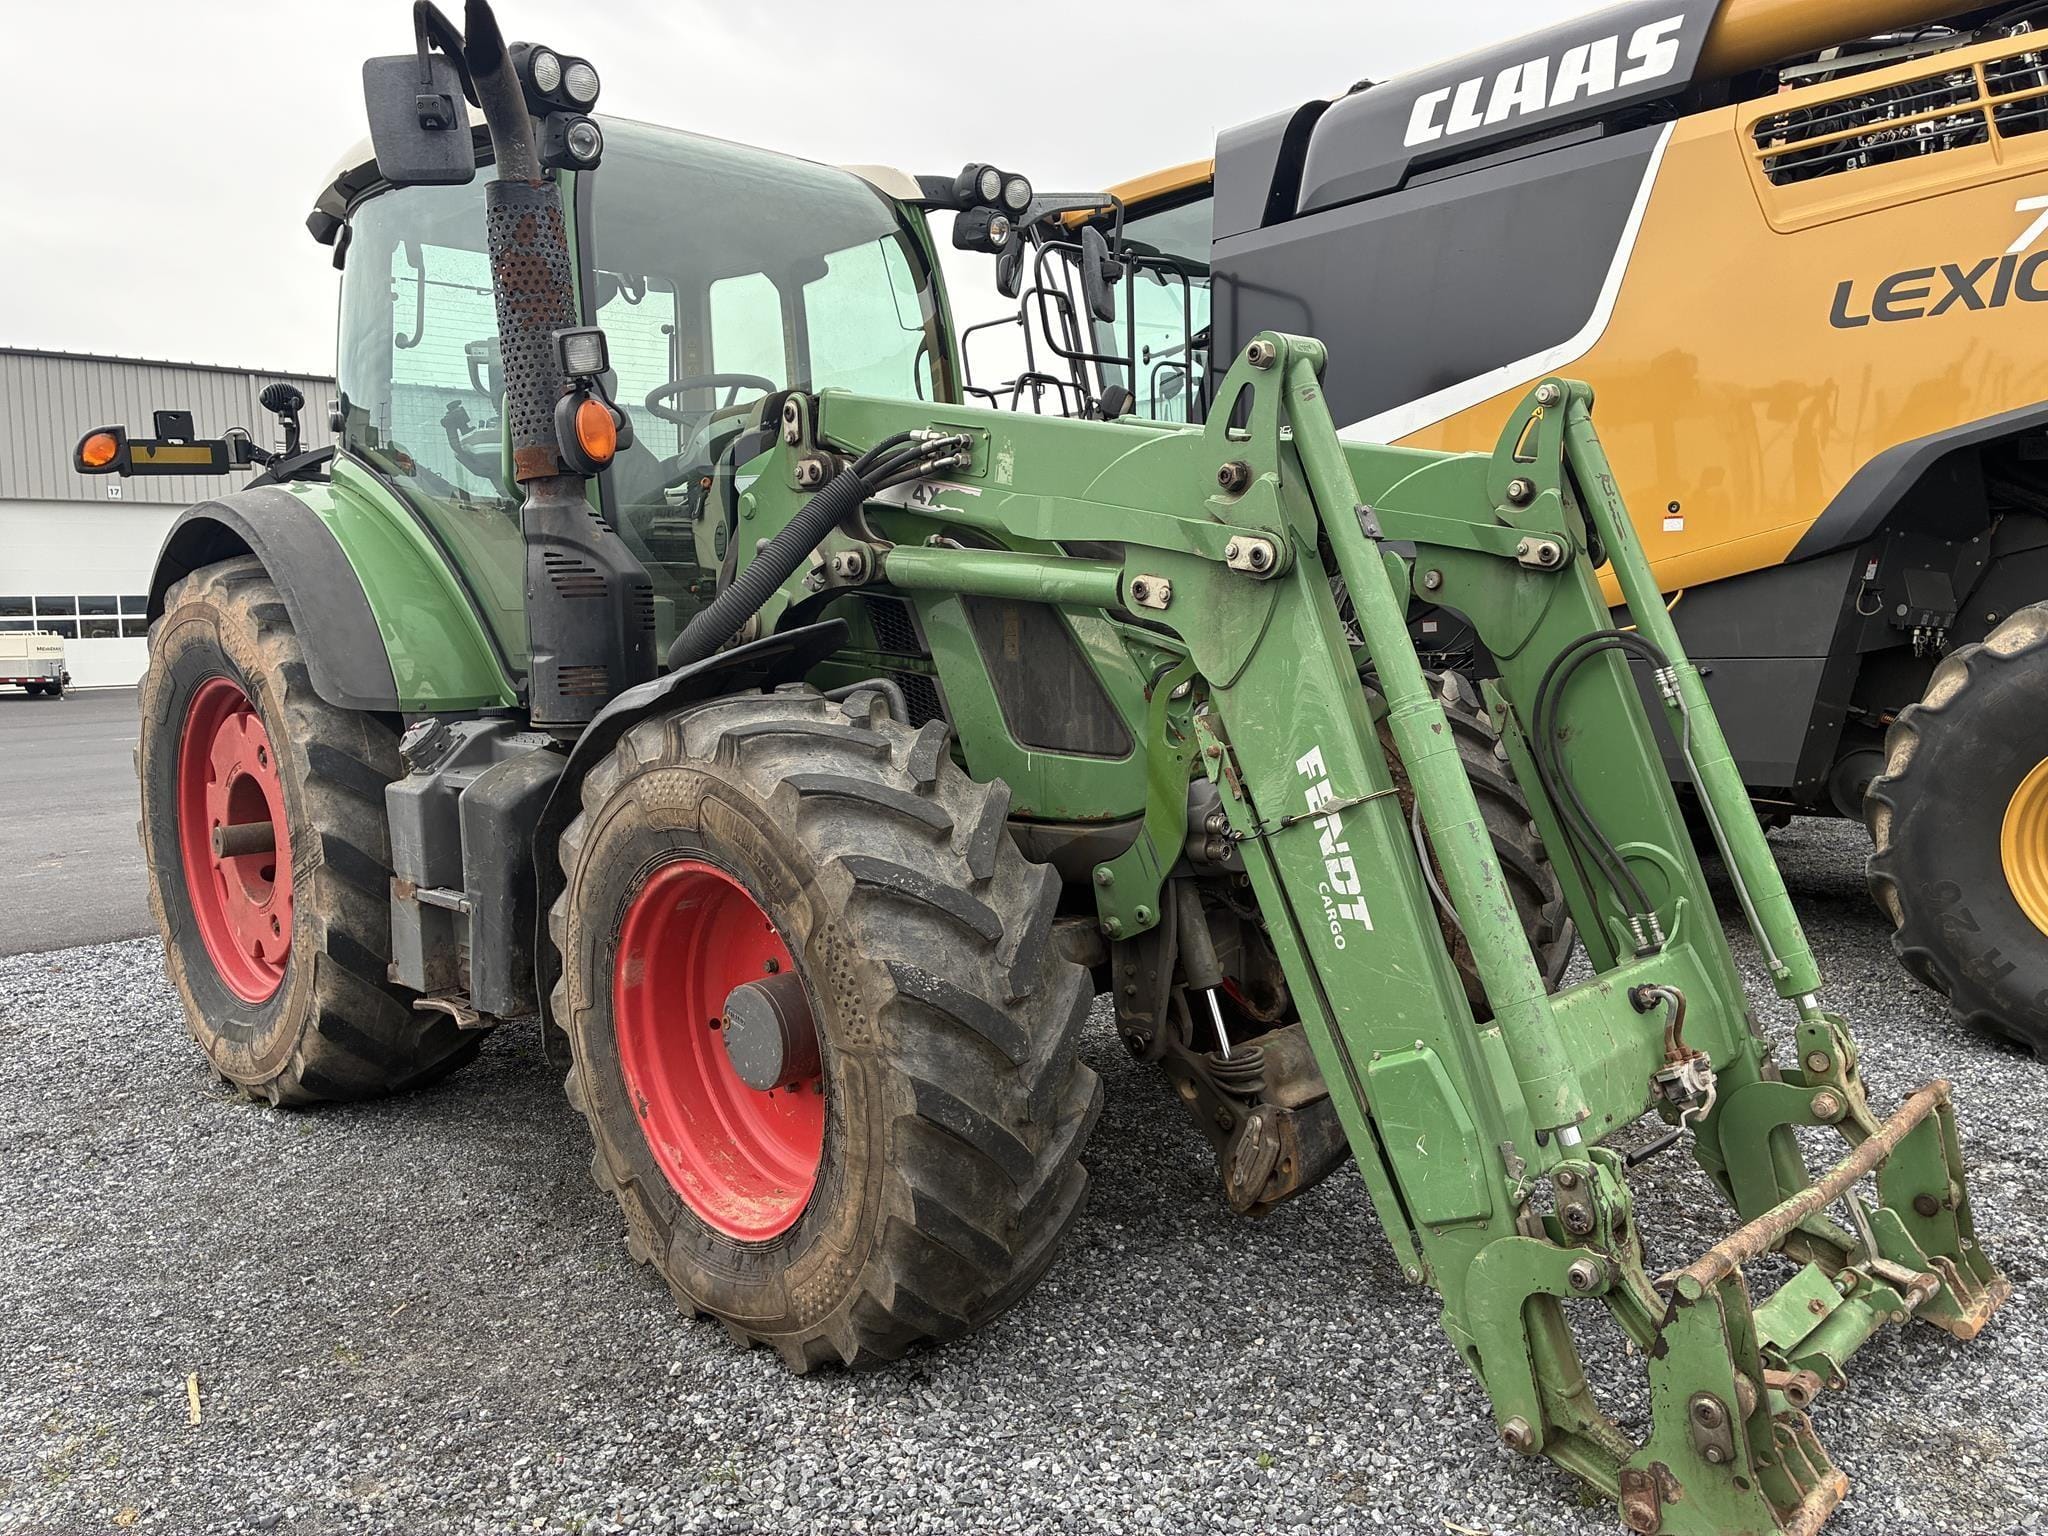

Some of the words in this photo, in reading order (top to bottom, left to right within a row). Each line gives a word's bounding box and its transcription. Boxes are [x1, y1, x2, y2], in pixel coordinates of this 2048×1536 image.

[1403, 14, 1685, 147] CLAAS
[109, 488, 120, 497] 17
[1296, 745, 1374, 931] FENDT
[1319, 881, 1346, 950] CARGO
